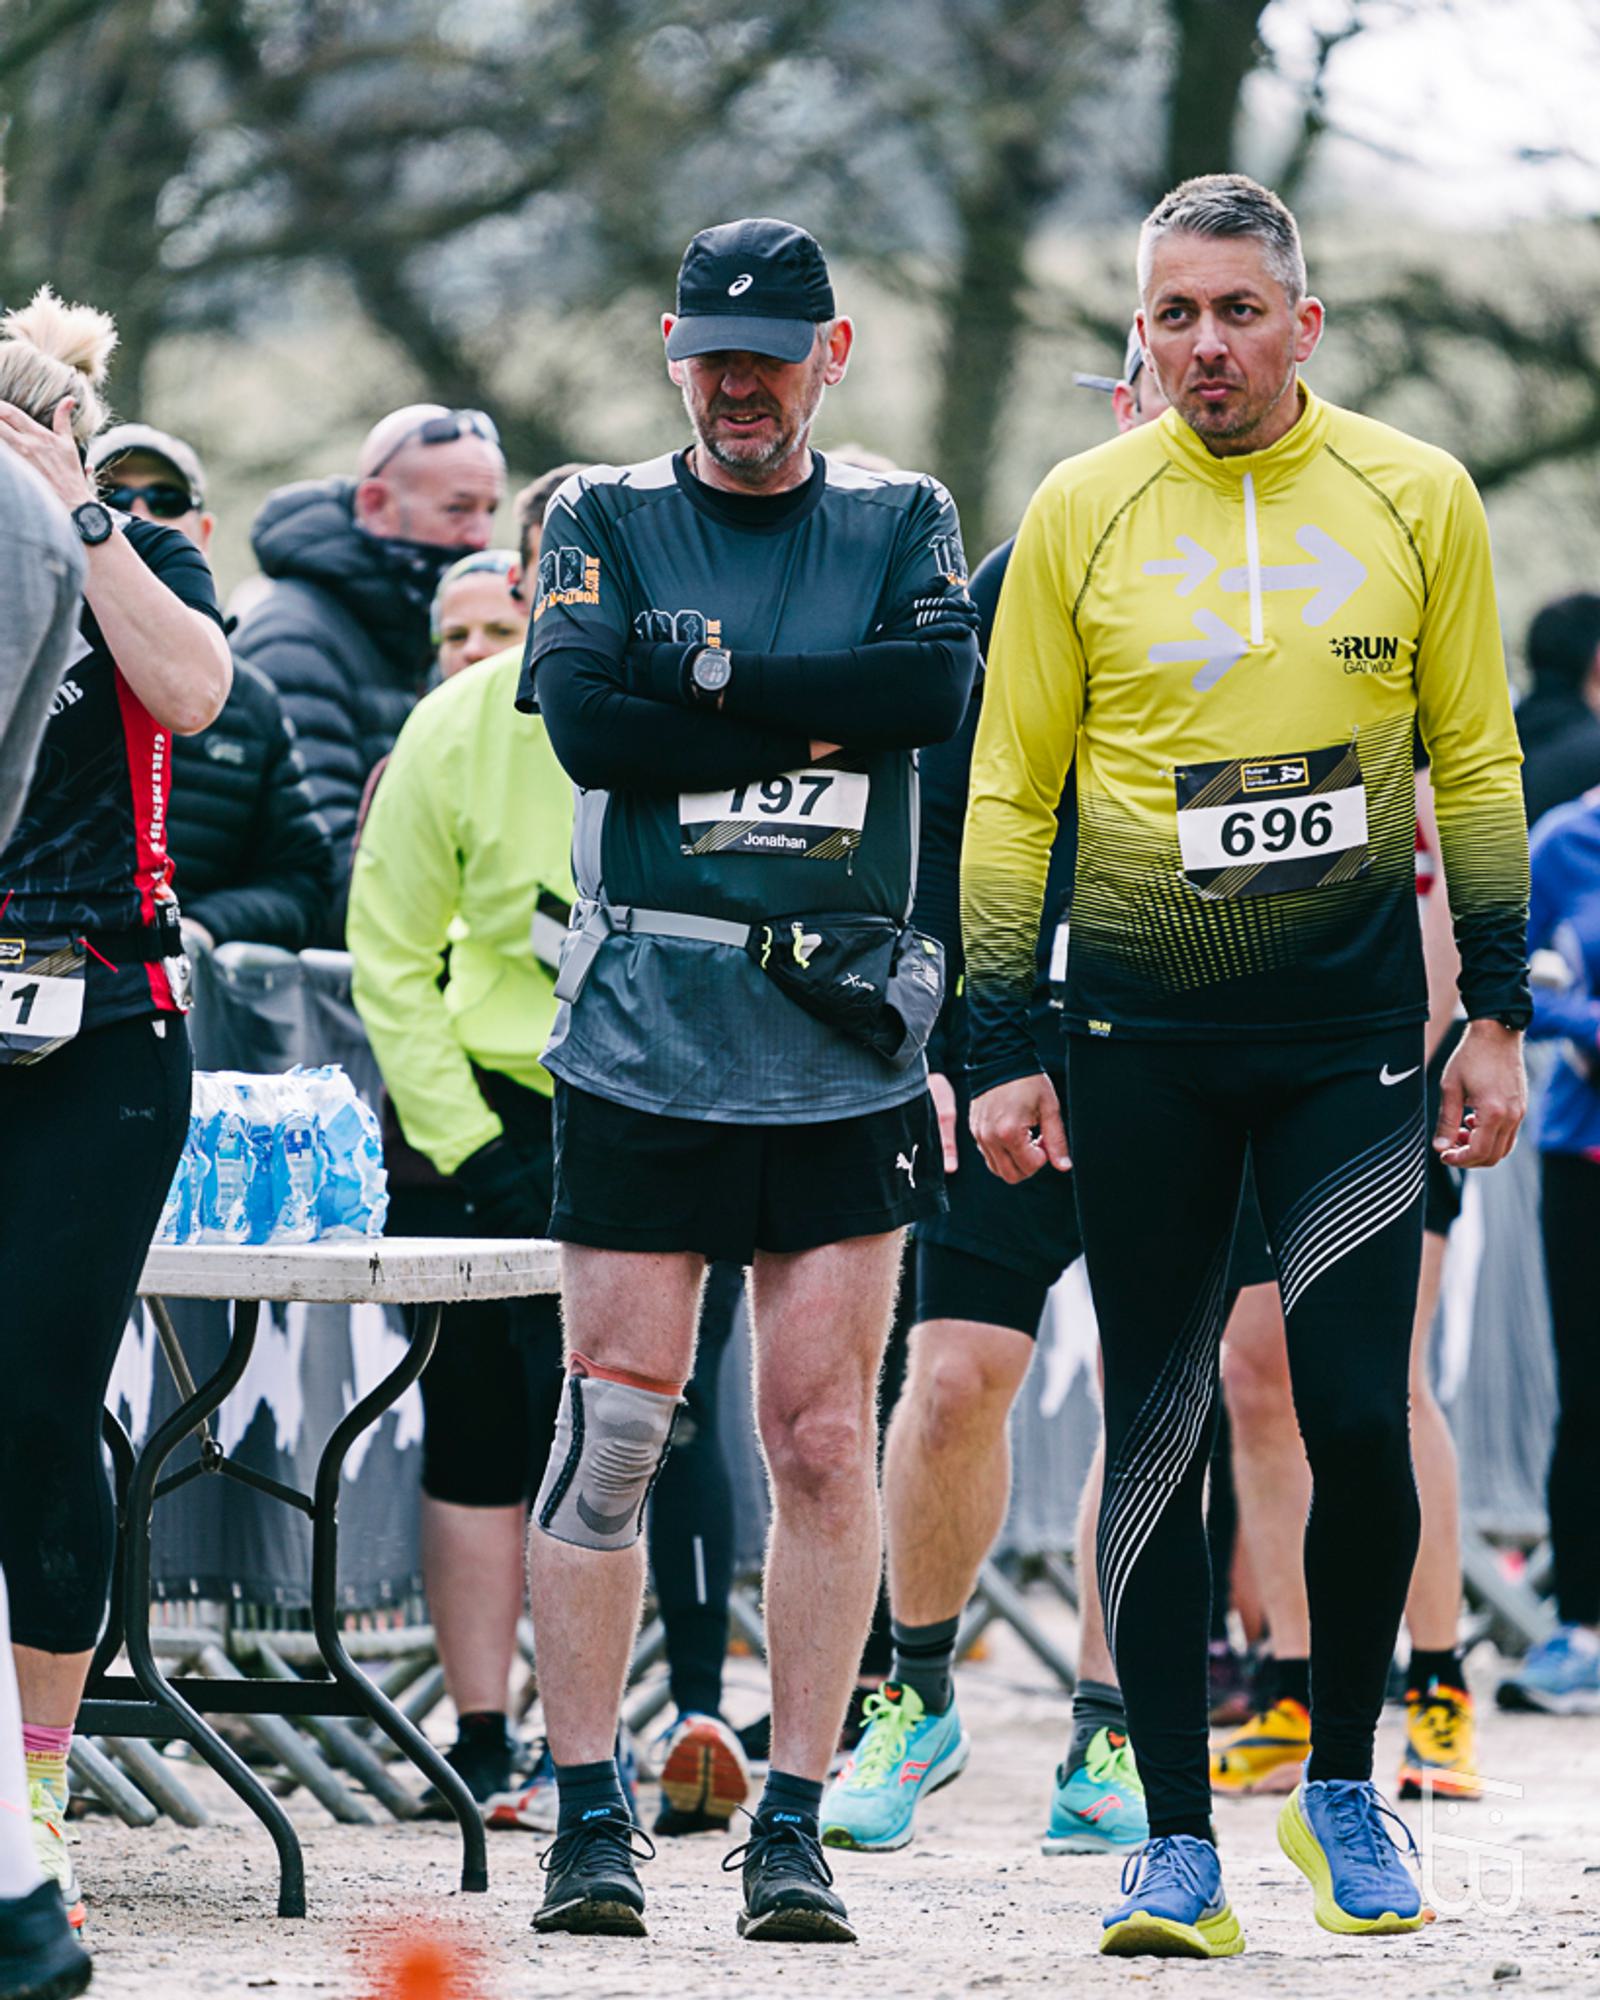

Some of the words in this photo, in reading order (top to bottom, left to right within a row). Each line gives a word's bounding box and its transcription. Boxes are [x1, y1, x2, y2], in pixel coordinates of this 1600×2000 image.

[1343, 636, 1398, 660] RUN
[743, 832, 807, 850] Jonathan
[1220, 801, 1333, 857] 696
[0, 980, 41, 1025] 1
